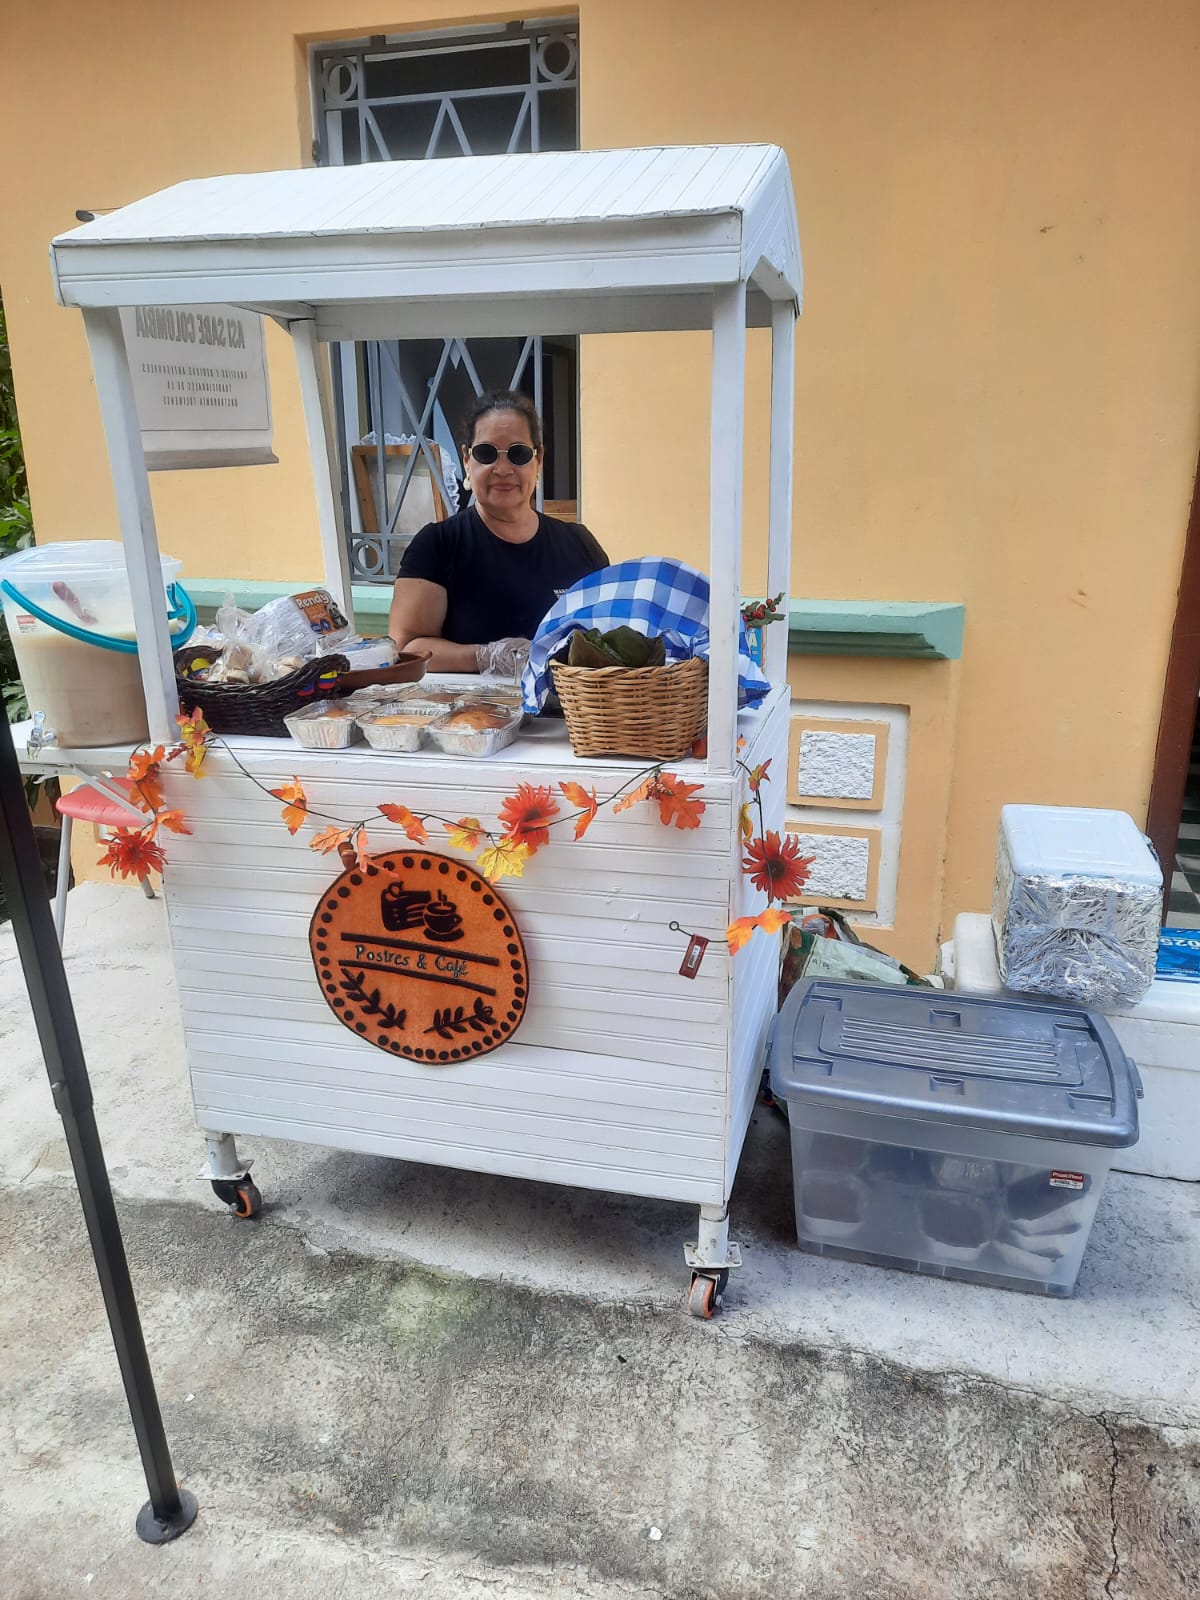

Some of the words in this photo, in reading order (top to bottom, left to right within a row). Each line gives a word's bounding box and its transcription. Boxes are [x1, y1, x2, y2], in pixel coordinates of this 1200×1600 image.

[296, 592, 330, 609] Rendy
[355, 944, 411, 966] Postres
[416, 953, 427, 970] &
[434, 955, 469, 979] Café
